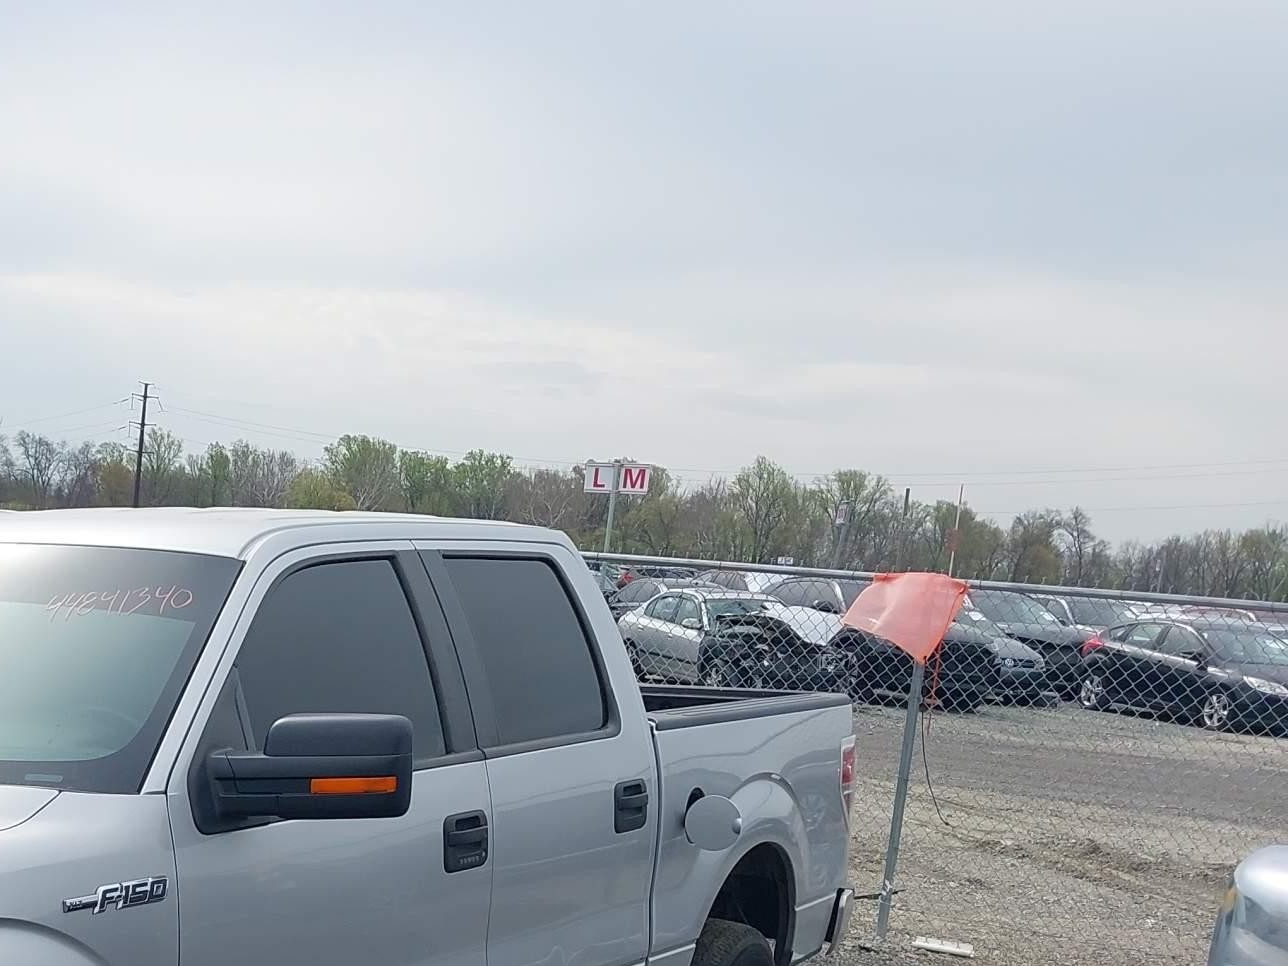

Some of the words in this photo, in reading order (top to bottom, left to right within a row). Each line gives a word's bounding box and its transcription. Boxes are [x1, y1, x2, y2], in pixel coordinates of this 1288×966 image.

[593, 467, 605, 488] L
[622, 468, 646, 489] M
[46, 585, 193, 623] 44841340
